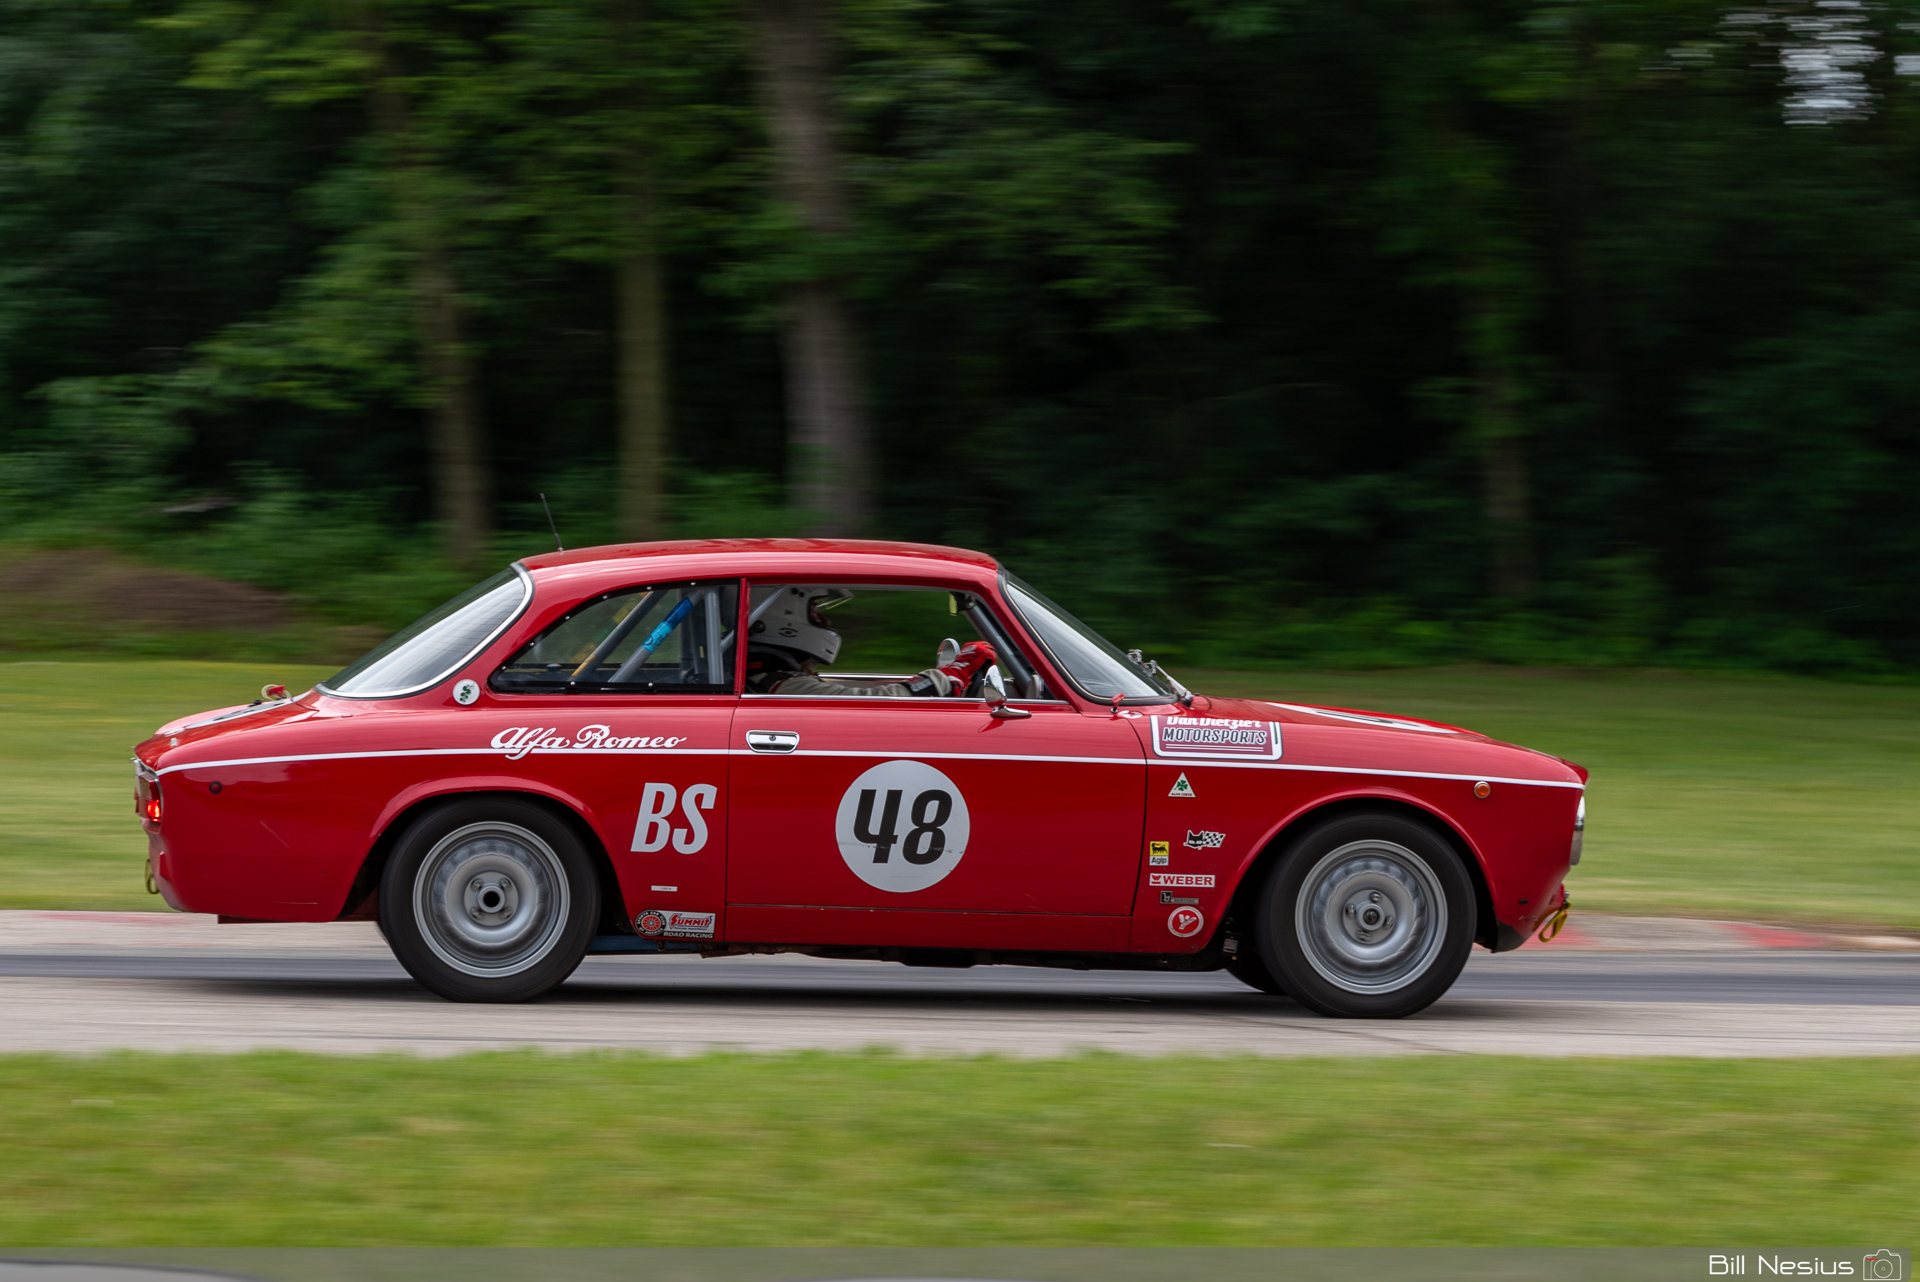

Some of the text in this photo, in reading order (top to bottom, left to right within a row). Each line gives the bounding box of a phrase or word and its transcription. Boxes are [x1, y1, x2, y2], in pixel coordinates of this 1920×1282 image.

[490, 724, 687, 761] Alfa Romeo
[1163, 727, 1267, 744] MOTORSPORTS
[630, 782, 718, 855] BS
[853, 788, 953, 866] 48
[1151, 856, 1167, 865] Agip
[1163, 875, 1213, 886] WEBER
